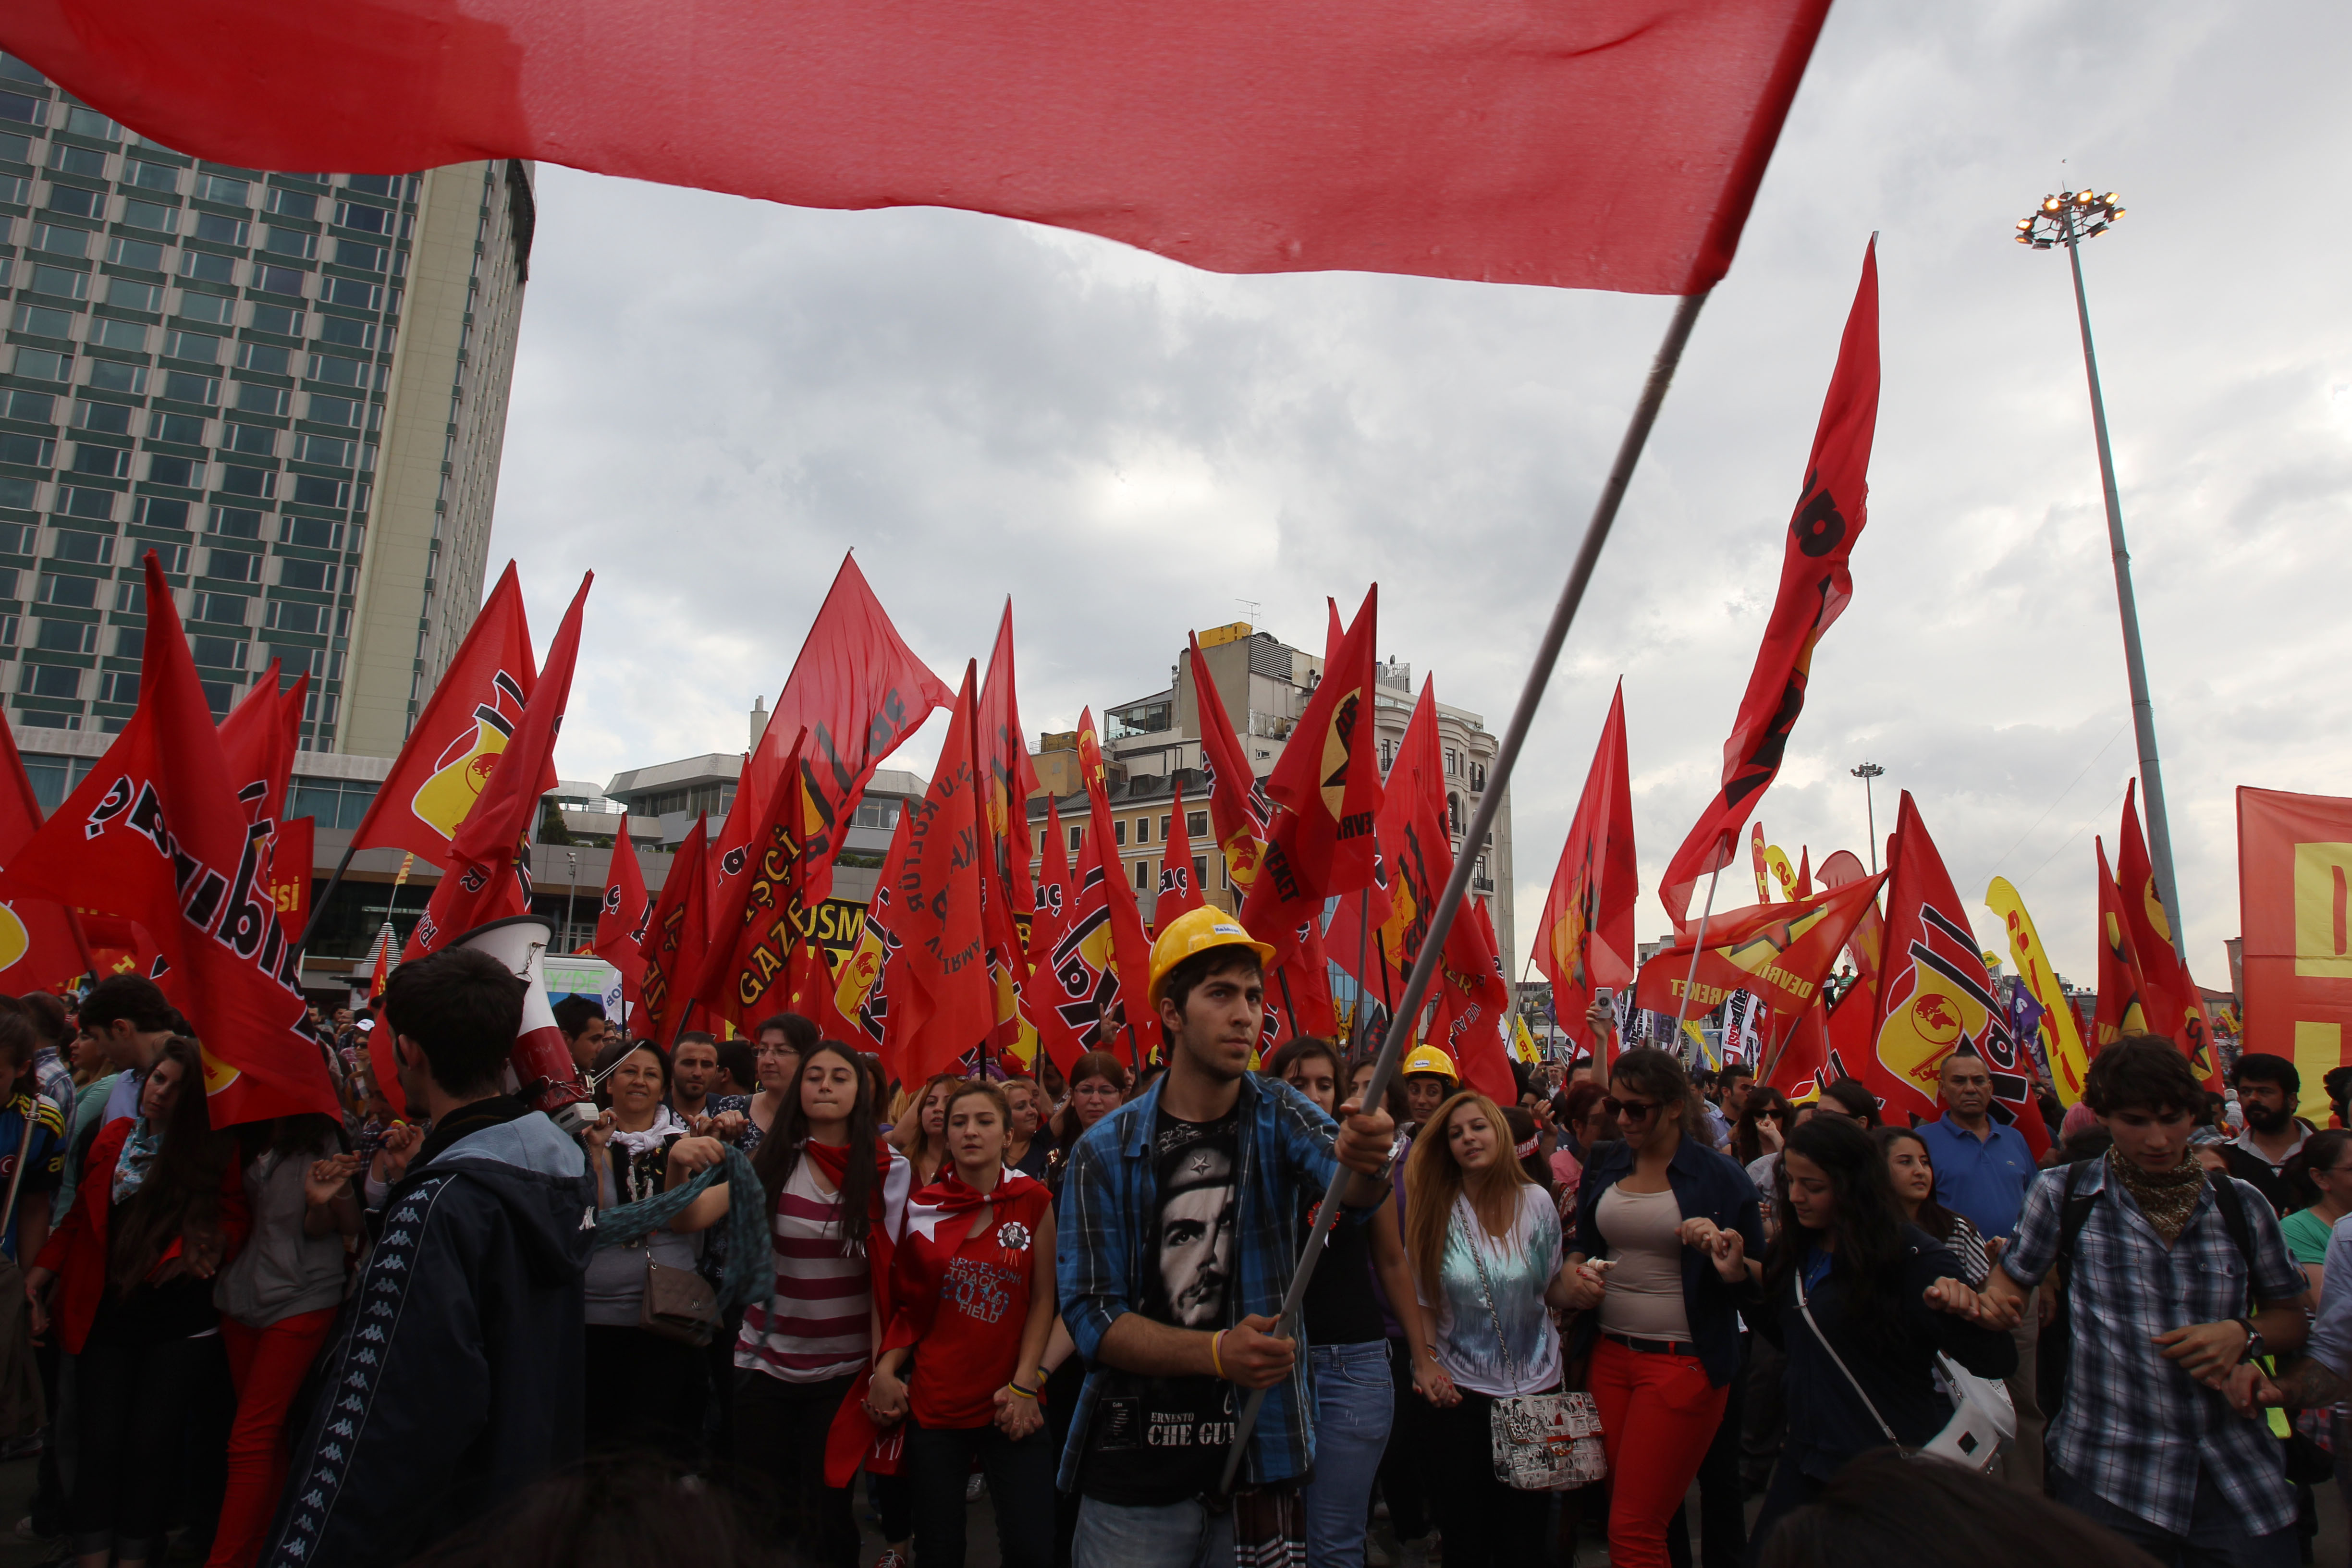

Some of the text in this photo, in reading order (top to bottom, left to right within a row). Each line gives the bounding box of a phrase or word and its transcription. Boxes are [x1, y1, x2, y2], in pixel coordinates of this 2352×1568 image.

[745, 826, 801, 923] ŞÇİ
[949, 1266, 1000, 1291] TRACK
[940, 1274, 1010, 1316] 2010
[986, 1295, 1002, 1305] AND
[958, 1302, 1000, 1324] FIELD
[1151, 1411, 1195, 1423] ERNESTO
[1147, 1424, 1192, 1446] CHE
